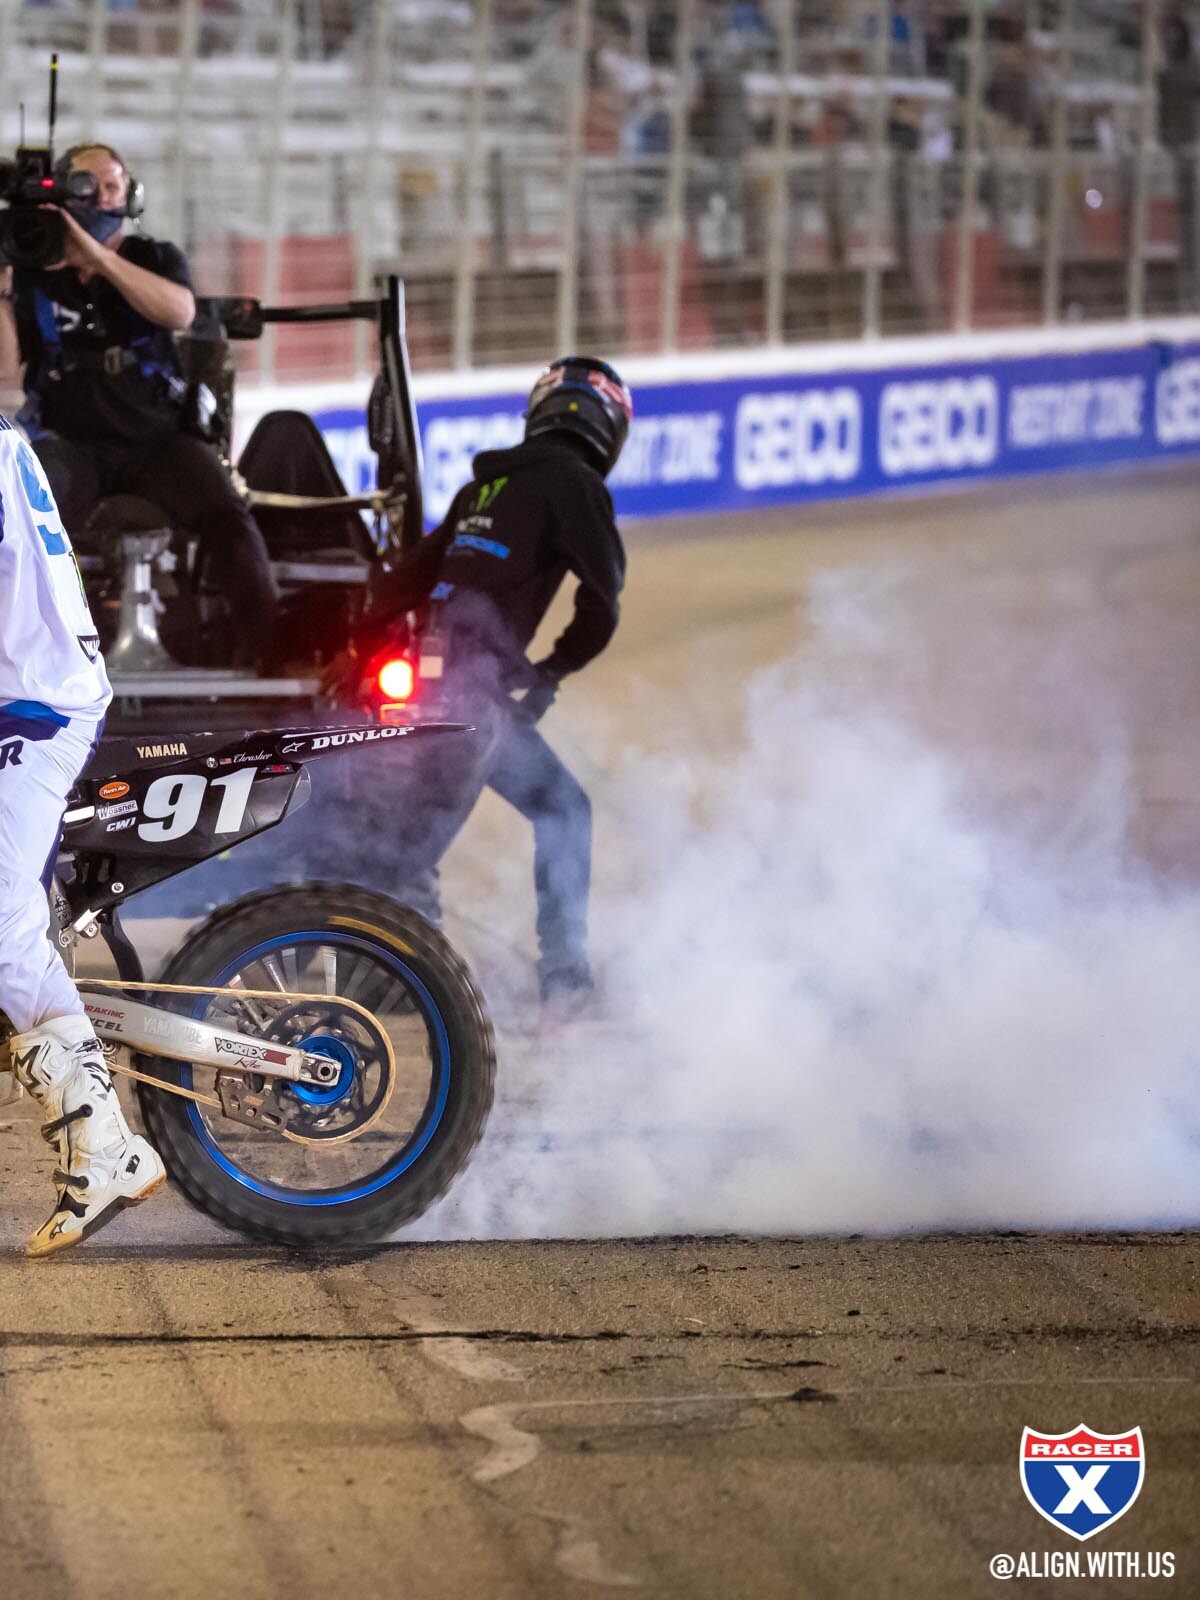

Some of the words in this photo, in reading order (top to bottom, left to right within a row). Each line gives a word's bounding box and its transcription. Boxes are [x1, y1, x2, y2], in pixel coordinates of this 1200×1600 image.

[734, 387, 861, 489] GEICO
[879, 376, 998, 477] GEICO
[311, 726, 415, 750] DUNLOP
[136, 742, 188, 759] YAMAHA
[137, 767, 258, 843] 91
[89, 1018, 123, 1033] XCEL
[215, 1037, 267, 1061] VORTEX
